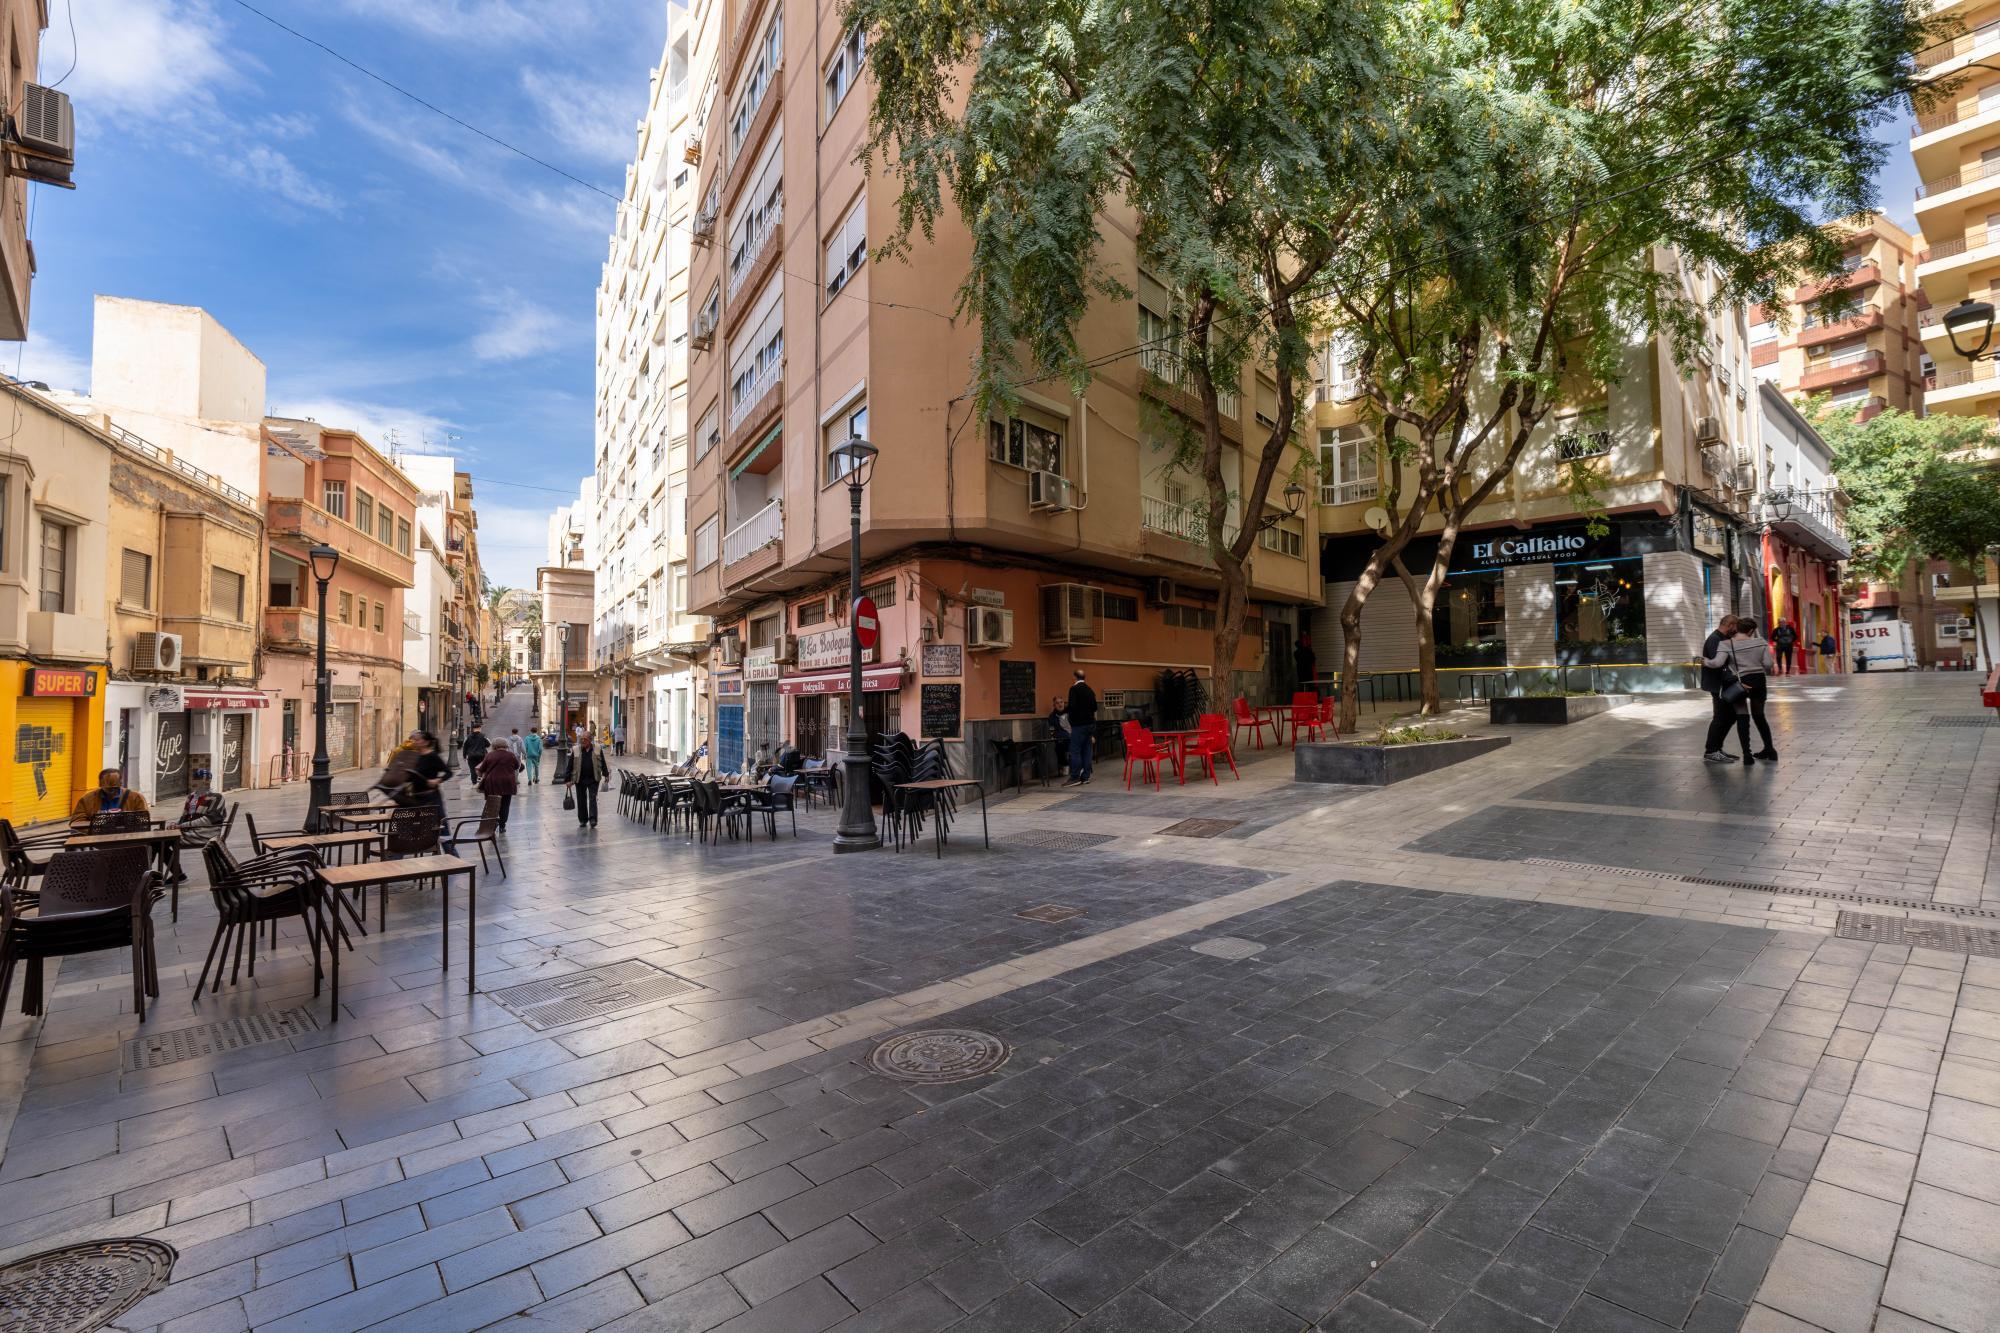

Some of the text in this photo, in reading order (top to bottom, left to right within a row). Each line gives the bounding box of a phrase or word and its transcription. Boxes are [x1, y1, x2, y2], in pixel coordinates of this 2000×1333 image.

[1473, 535, 1586, 559] El Callaito
[1521, 554, 1552, 562] CASUAL
[1554, 551, 1577, 559] FOOD
[820, 632, 851, 655] Bodegui
[37, 674, 94, 692] SUPER 8
[752, 668, 778, 679] GRANJA
[156, 720, 184, 780] Lupe
